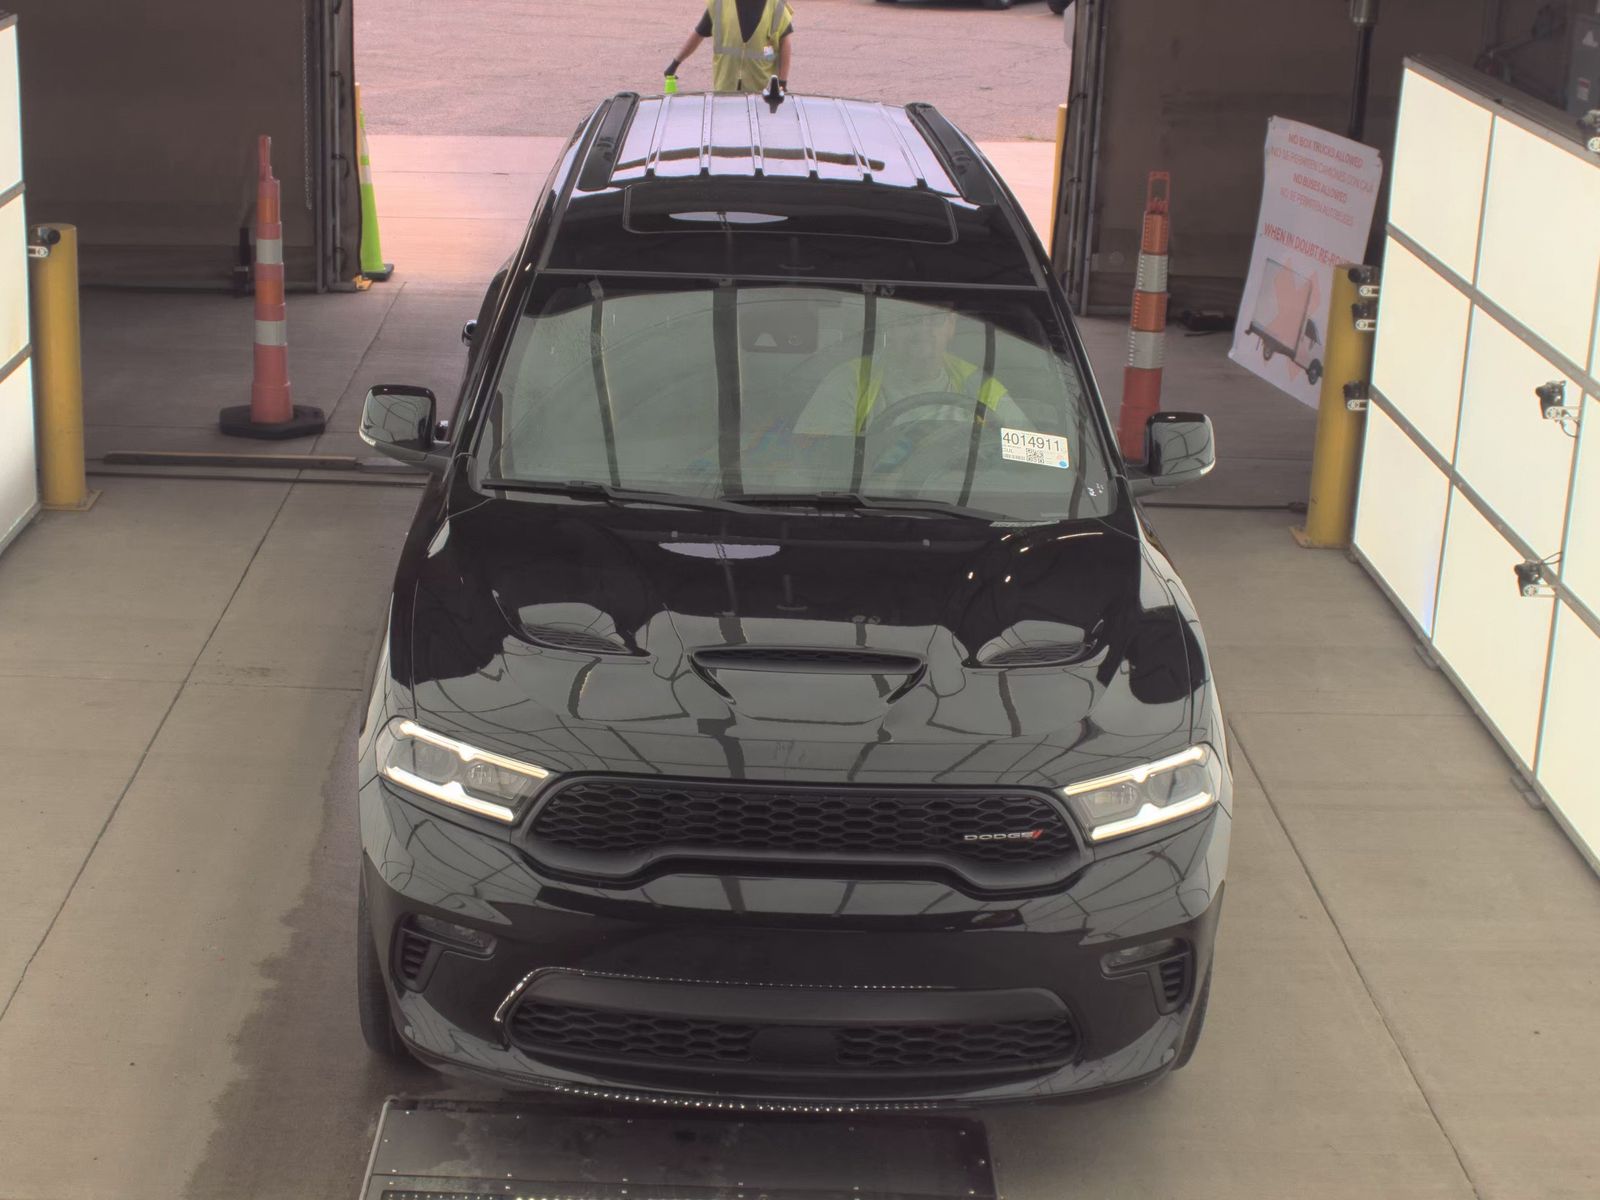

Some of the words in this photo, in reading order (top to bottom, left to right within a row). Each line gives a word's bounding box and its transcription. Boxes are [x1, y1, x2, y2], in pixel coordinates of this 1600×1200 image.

[1288, 133, 1298, 145] NO
[1300, 136, 1312, 148] BOX
[1313, 141, 1335, 157] TRUCKS
[1336, 151, 1363, 168] ALLOWED
[1293, 172, 1302, 185] NO
[1303, 176, 1320, 192] BUSES
[1320, 185, 1347, 203] ALLOWED
[1264, 223, 1285, 244] WHEN
[1286, 231, 1294, 249] IN
[1295, 237, 1318, 260] DOUBT
[1003, 432, 1060, 452] 4014911
[964, 832, 1033, 841] DODGE
